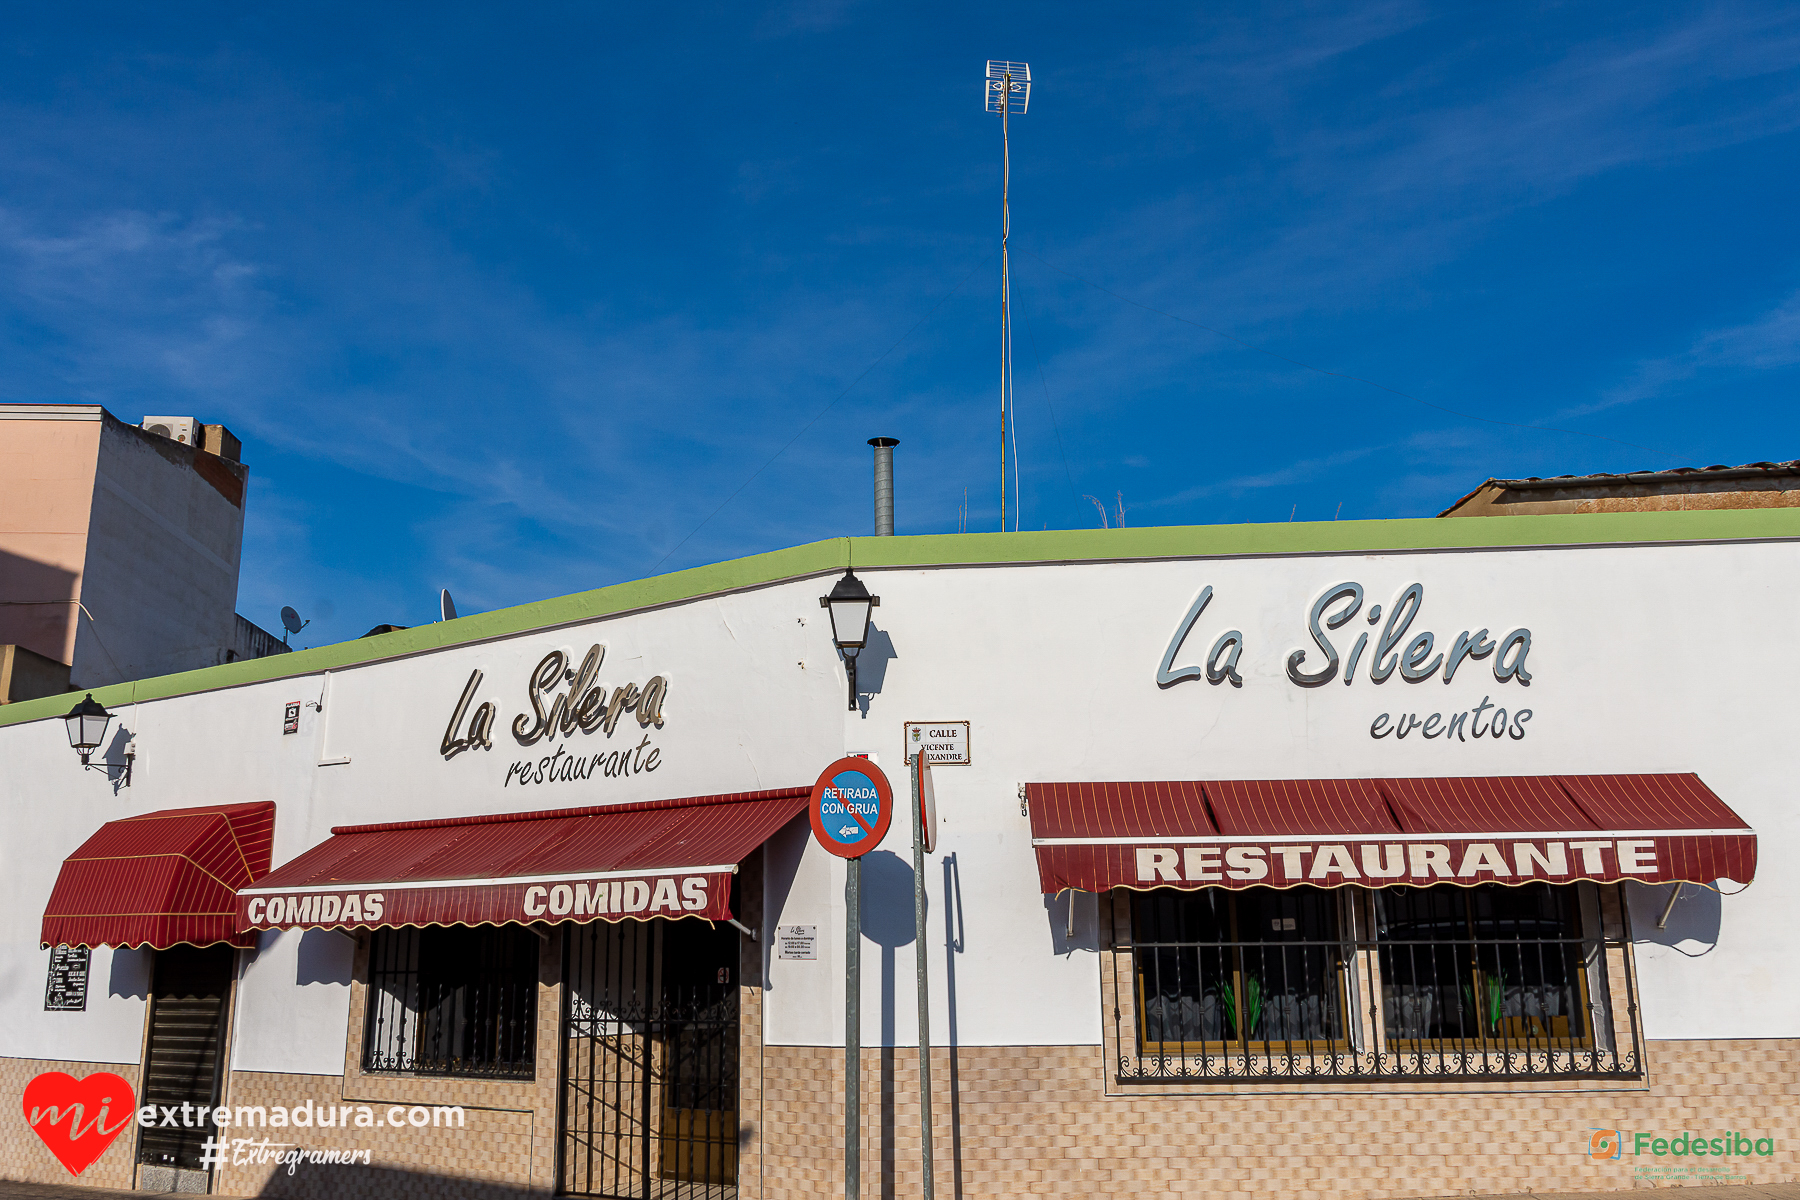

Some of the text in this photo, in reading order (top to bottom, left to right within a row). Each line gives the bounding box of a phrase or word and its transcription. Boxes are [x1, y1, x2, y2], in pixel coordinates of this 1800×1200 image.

[1156, 582, 1533, 689] La Silera
[440, 643, 668, 761] La Silera
[1370, 696, 1533, 742] eventos
[921, 743, 954, 751] VICENTE
[929, 729, 957, 738] CALLE
[504, 734, 662, 788] restaurante
[909, 753, 962, 761] IXANDRE
[821, 803, 878, 815] CON GRUA
[824, 788, 877, 799] RETIRADA
[1136, 840, 1658, 881] RESTAURANTE
[248, 893, 385, 924] COMIDAS
[523, 877, 708, 917] COMIDAS
